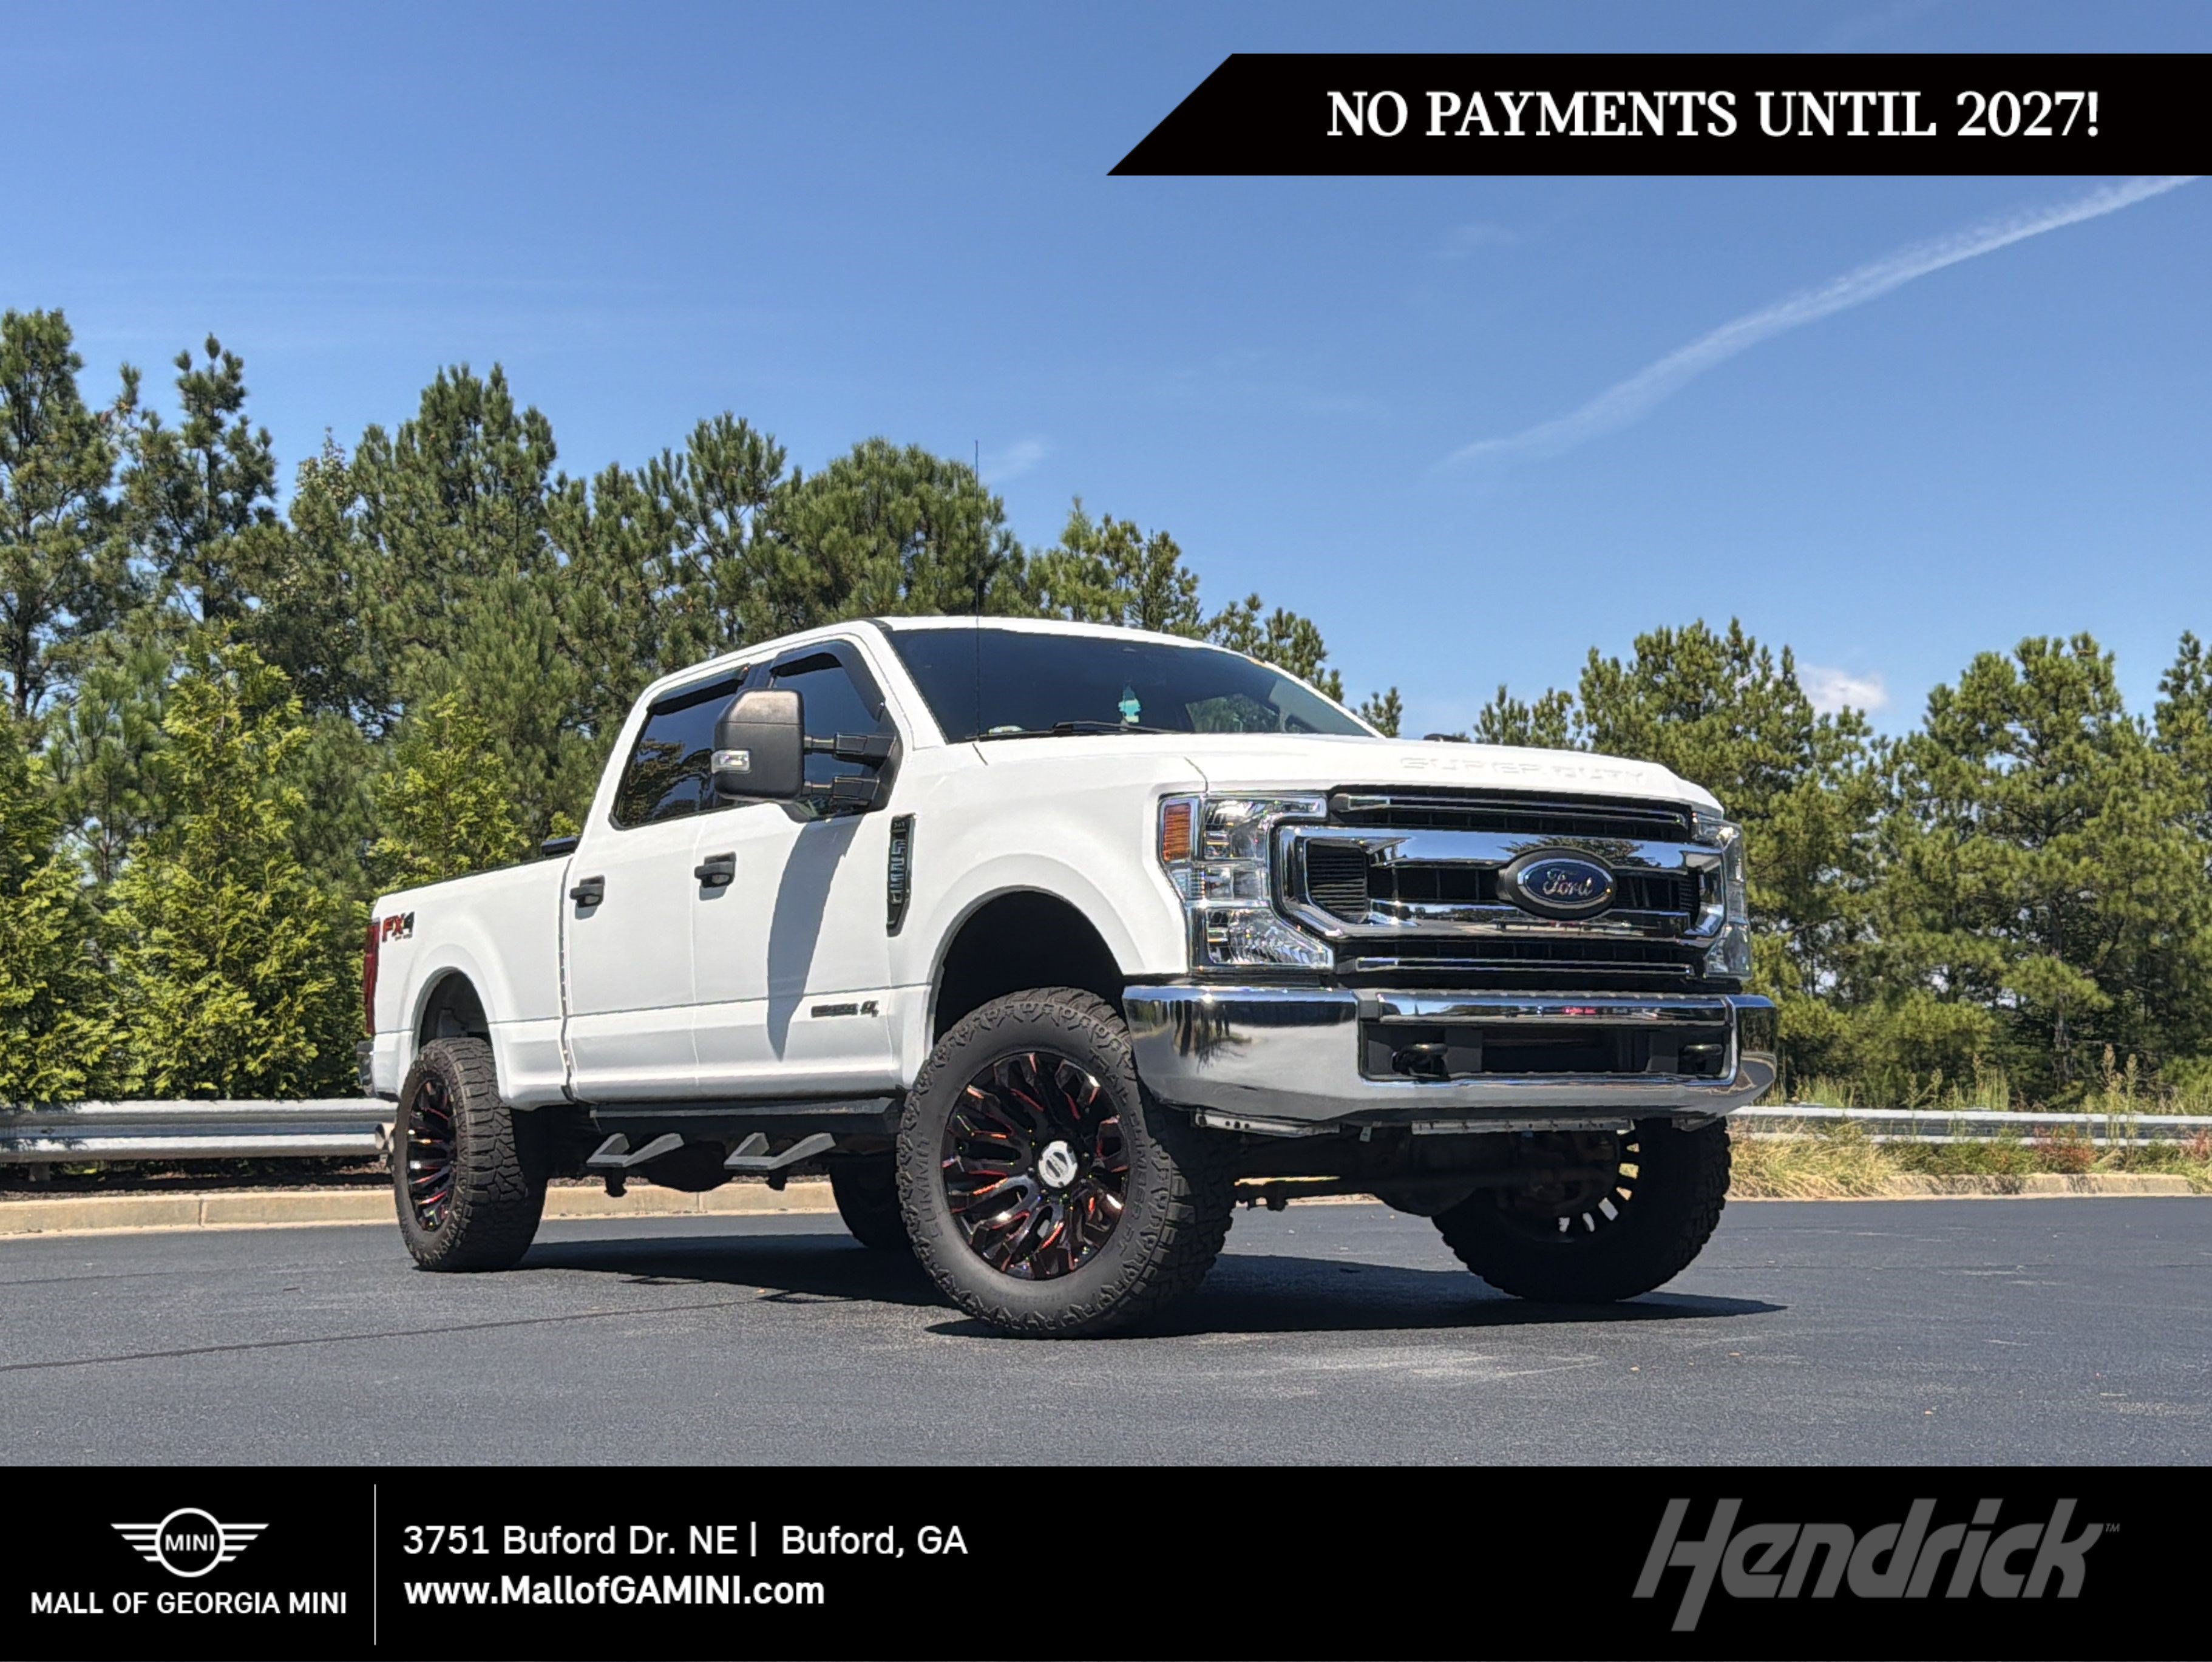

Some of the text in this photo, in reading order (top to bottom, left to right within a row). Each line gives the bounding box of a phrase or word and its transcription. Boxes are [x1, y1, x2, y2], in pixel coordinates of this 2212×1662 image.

[1399, 756, 1542, 775] SUPER
[1542, 867, 1593, 897] Ford
[381, 911, 415, 943] FX4
[1088, 1047, 1128, 1105] TRAIL
